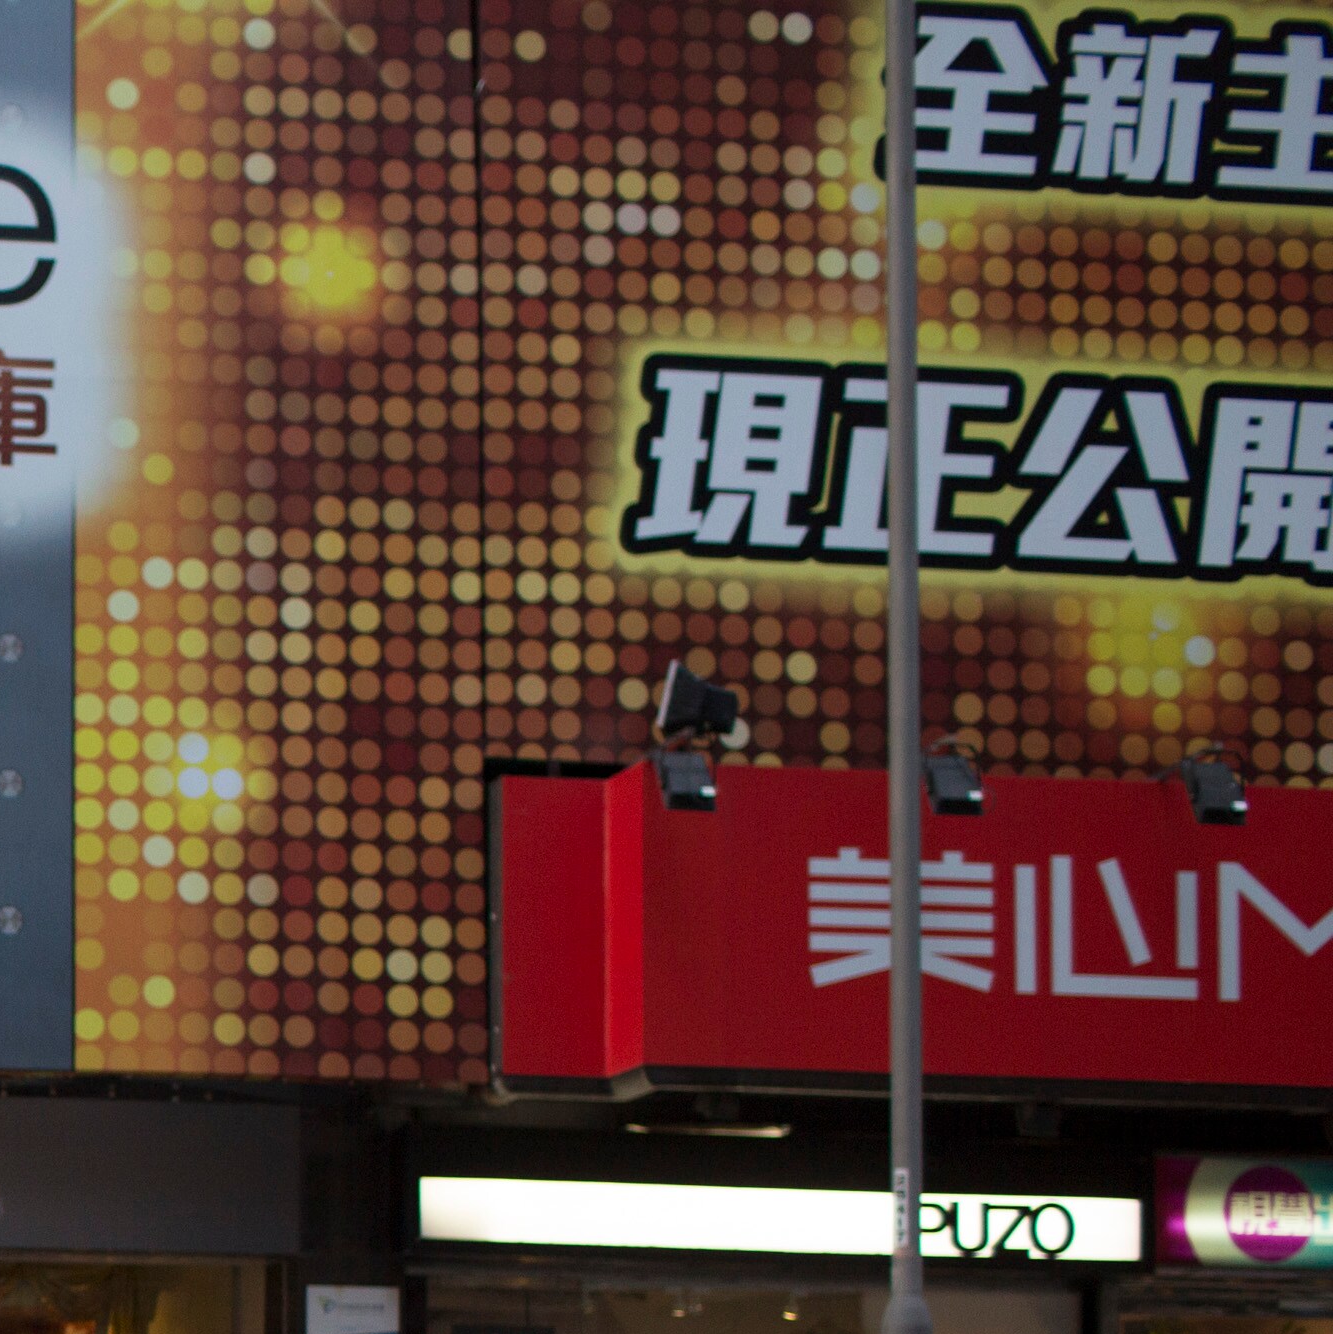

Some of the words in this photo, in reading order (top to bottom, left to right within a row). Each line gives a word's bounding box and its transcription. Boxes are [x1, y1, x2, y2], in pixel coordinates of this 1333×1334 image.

[634, 368, 1333, 572] 現正公開
[920, 1201, 1076, 1255] PUZO
